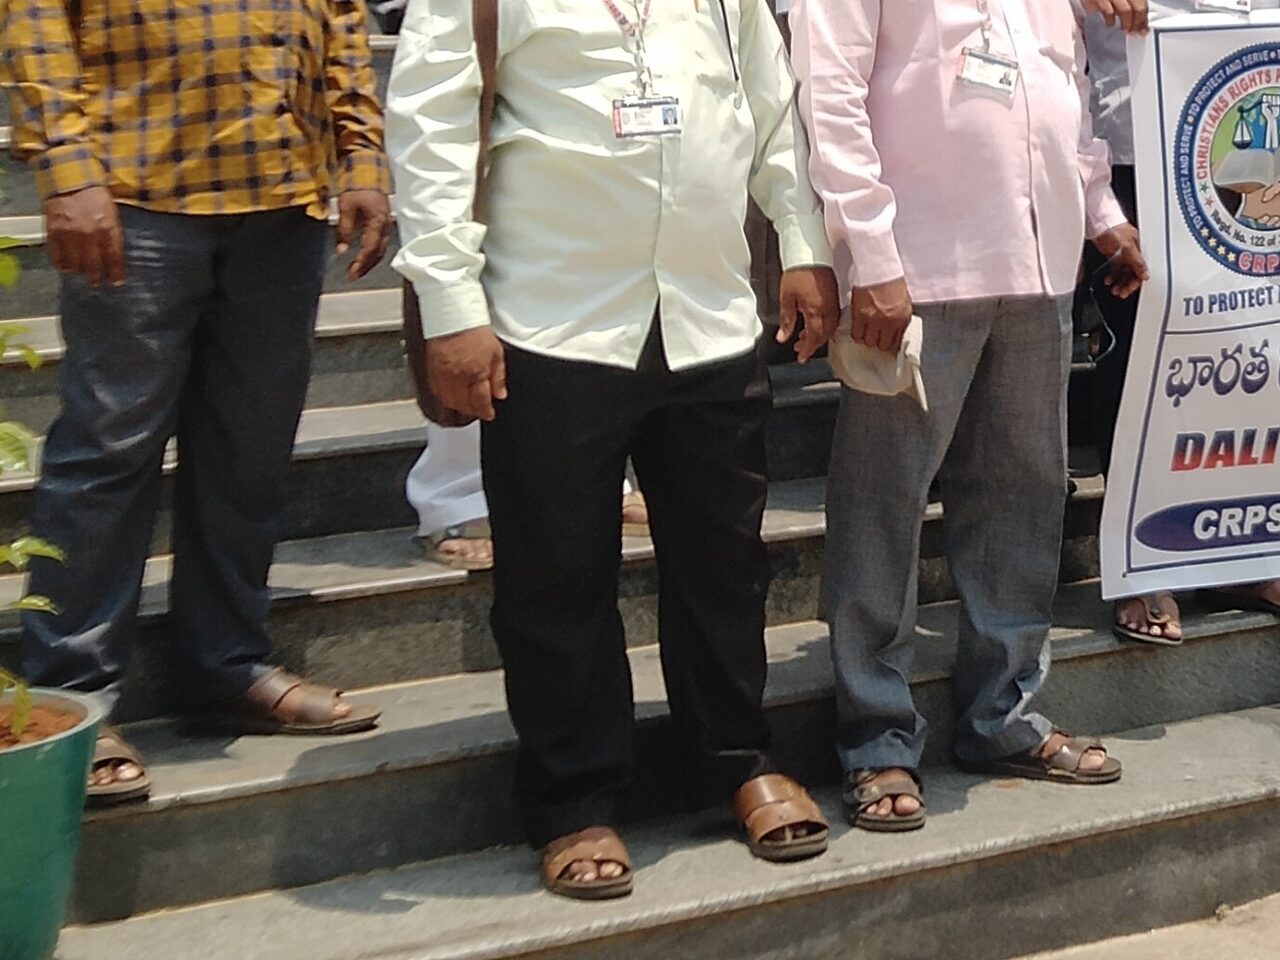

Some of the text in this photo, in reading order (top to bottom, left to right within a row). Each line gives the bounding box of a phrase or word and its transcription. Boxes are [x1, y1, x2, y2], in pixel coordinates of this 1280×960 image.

[1195, 96, 1230, 181] CHRISTIANS
[1228, 68, 1272, 101] RIGHTS
[1249, 234, 1265, 247] 122
[1265, 236, 1277, 247] of
[1183, 296, 1203, 317] TO
[1207, 284, 1273, 315] PROTECT
[1165, 338, 1270, 408] భారత
